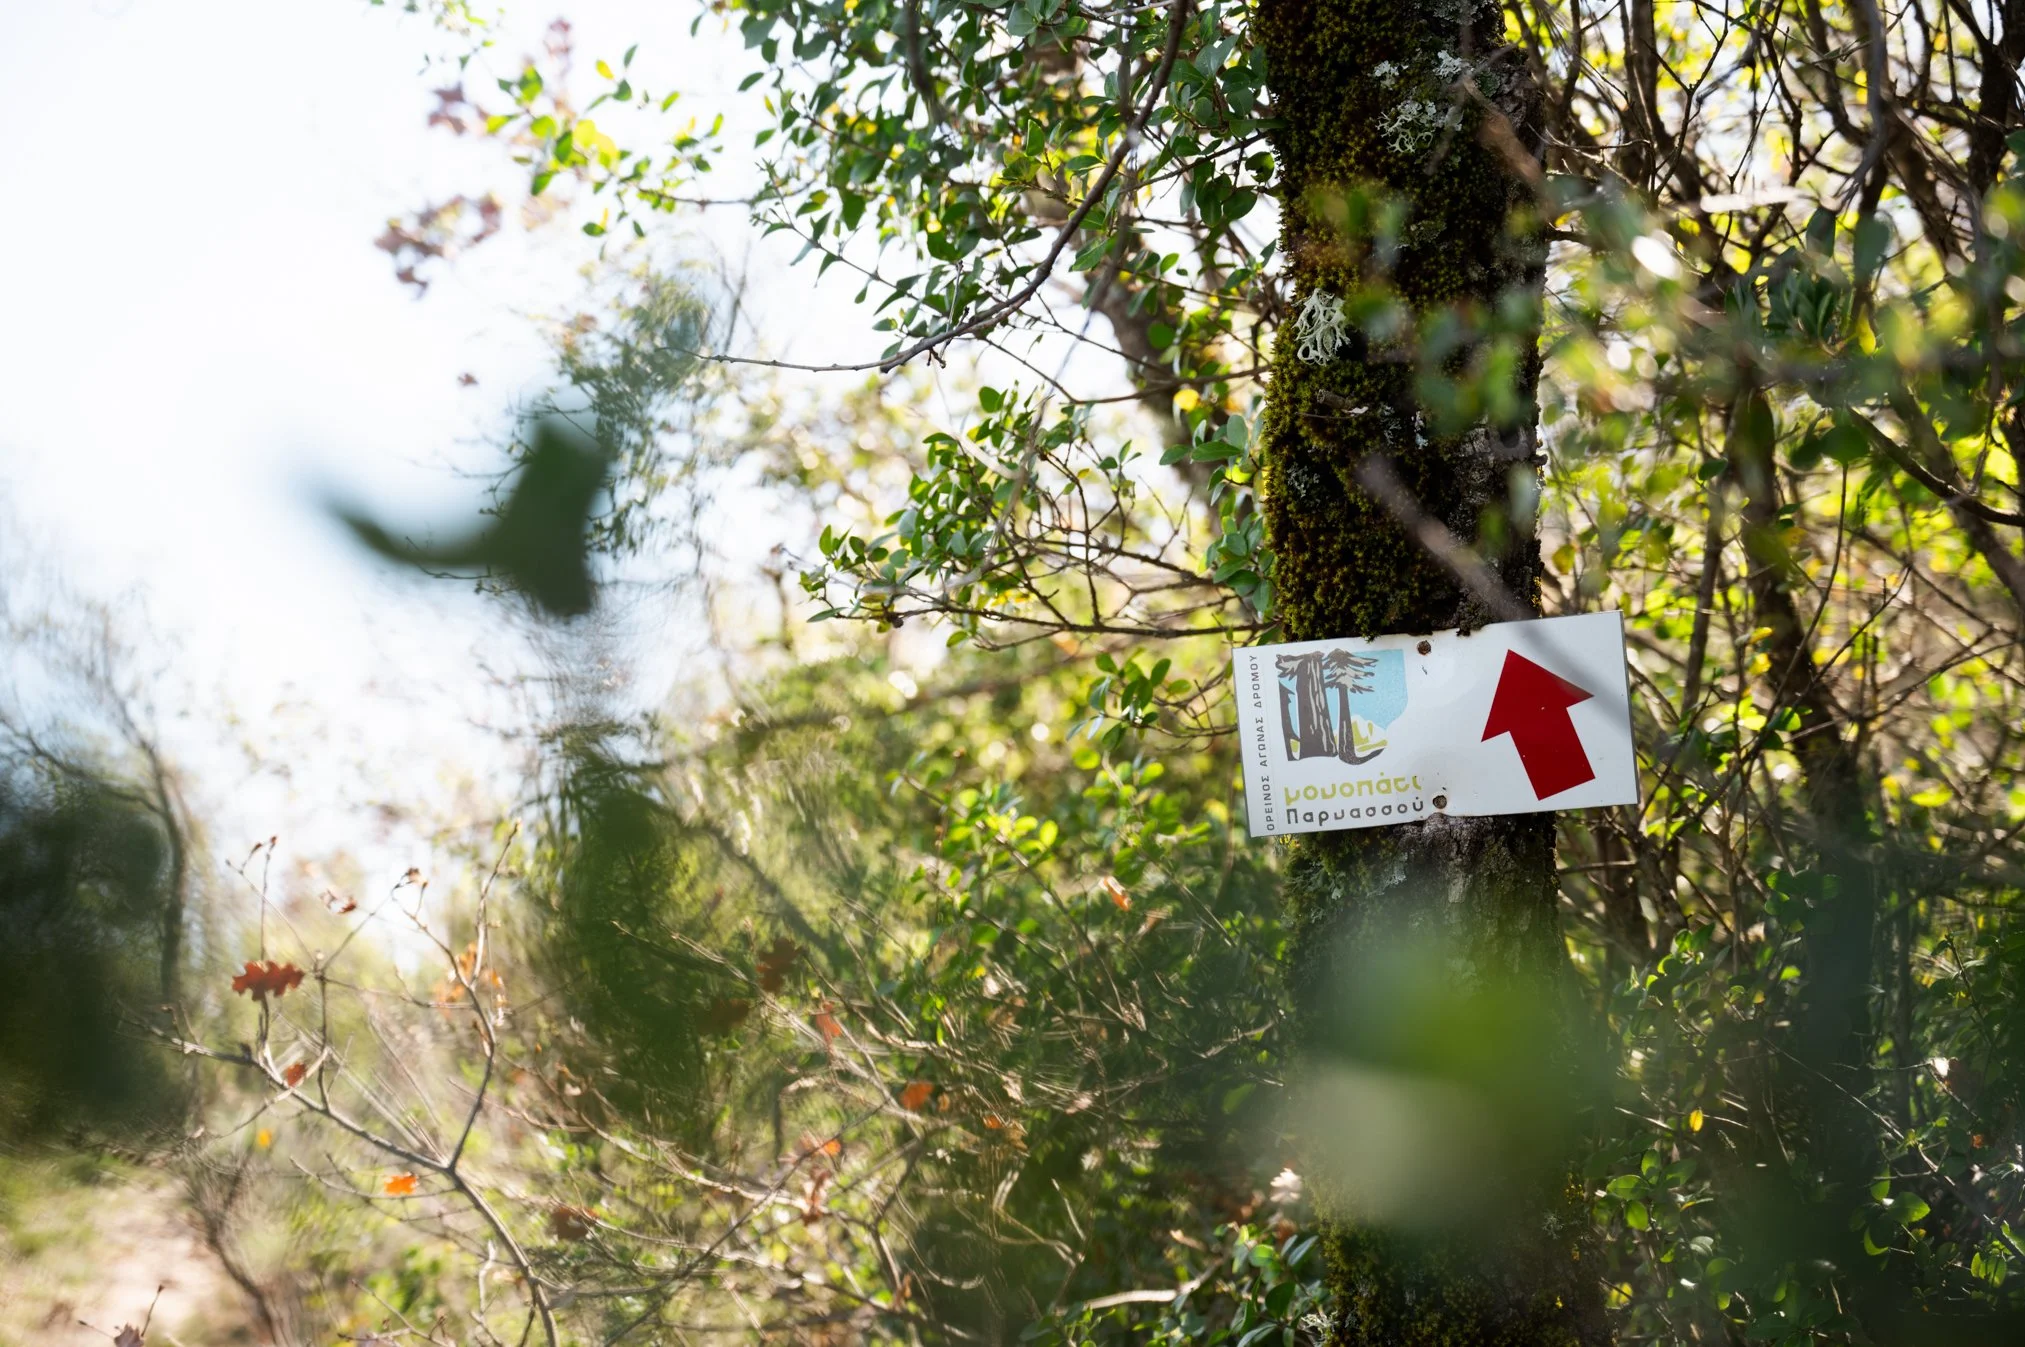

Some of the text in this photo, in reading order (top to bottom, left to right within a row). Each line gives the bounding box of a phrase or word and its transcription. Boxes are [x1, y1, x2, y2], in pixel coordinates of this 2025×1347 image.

[1249, 655, 1275, 831] ΟΡΕΙΝΟΣ ΑΓΩΝΑΣ ΔΡΟΜΟΥ
